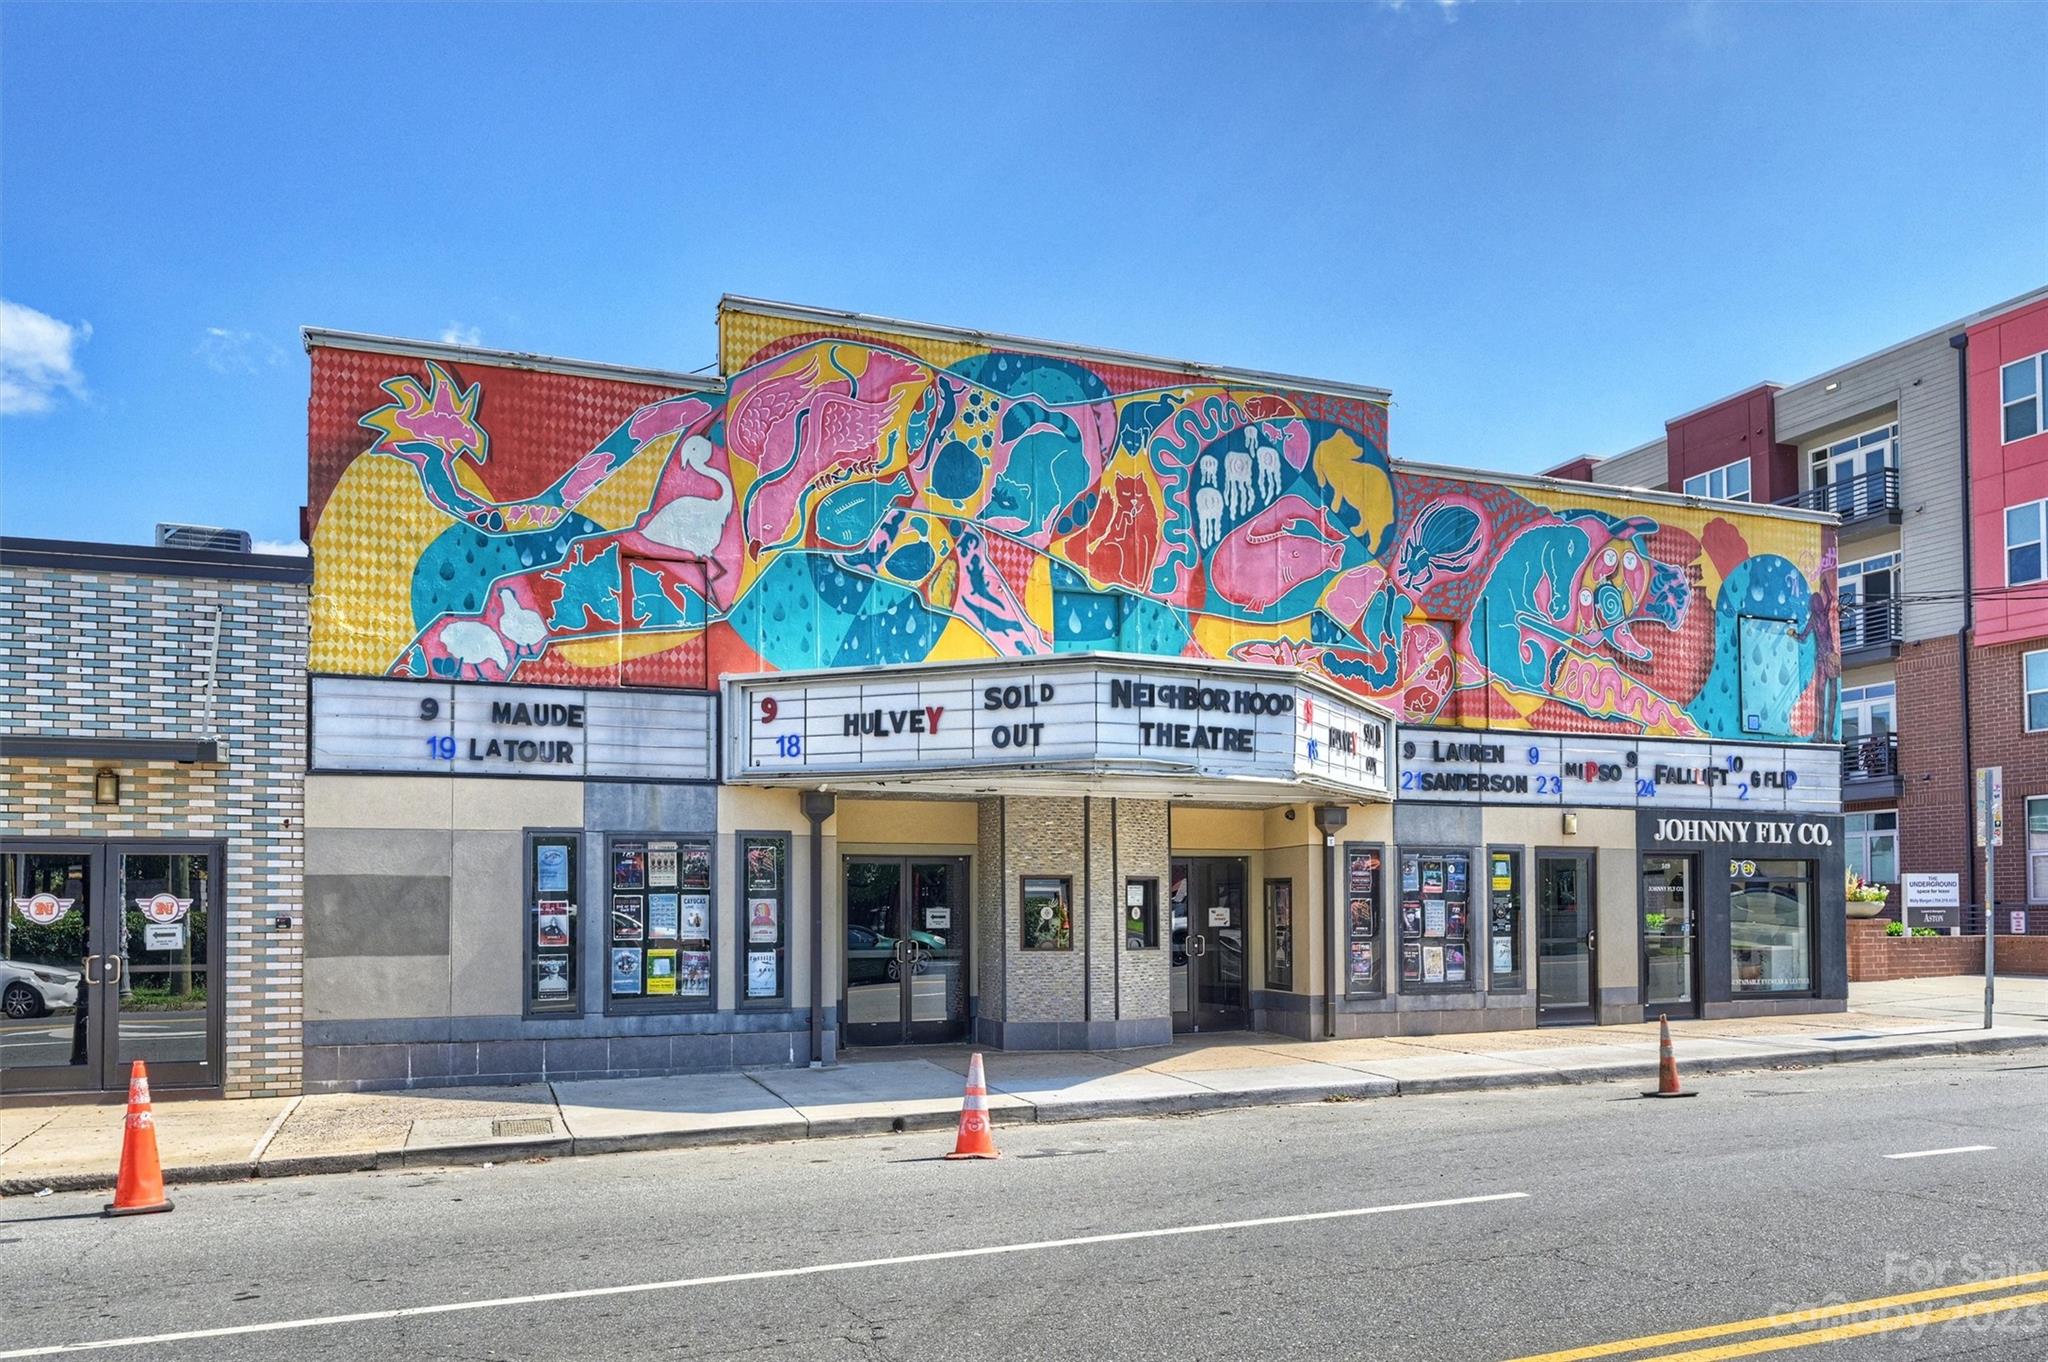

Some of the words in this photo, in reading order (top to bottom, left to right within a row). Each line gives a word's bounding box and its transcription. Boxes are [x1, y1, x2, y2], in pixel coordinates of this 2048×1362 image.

[984, 683, 1055, 711] SOLD
[420, 697, 439, 721] 9
[491, 701, 584, 728] MAUDE
[761, 697, 778, 724] 9
[843, 706, 944, 737] HULVEY
[776, 735, 801, 758] 18
[991, 723, 1044, 749] OUT
[1139, 722, 1254, 753] THEATRE
[426, 736, 456, 760] 19
[469, 738, 574, 764] LATOUR
[1403, 741, 1416, 760] 9
[1433, 740, 1504, 763] LAUREN
[1528, 746, 1539, 765] 9
[1626, 751, 1638, 768] 9
[1565, 761, 1622, 783] MIPSO
[1726, 755, 1743, 773] 10
[1401, 771, 1421, 790] 21
[1421, 773, 1528, 793] SANDERSON
[1636, 779, 1656, 797] 24
[1738, 783, 1749, 800] 2
[1751, 771, 1761, 788] G
[1765, 770, 1797, 790] FLIP
[1653, 819, 1751, 842] JOHNNY
[1755, 822, 1794, 844] FLY
[1797, 823, 1832, 846] CO.
